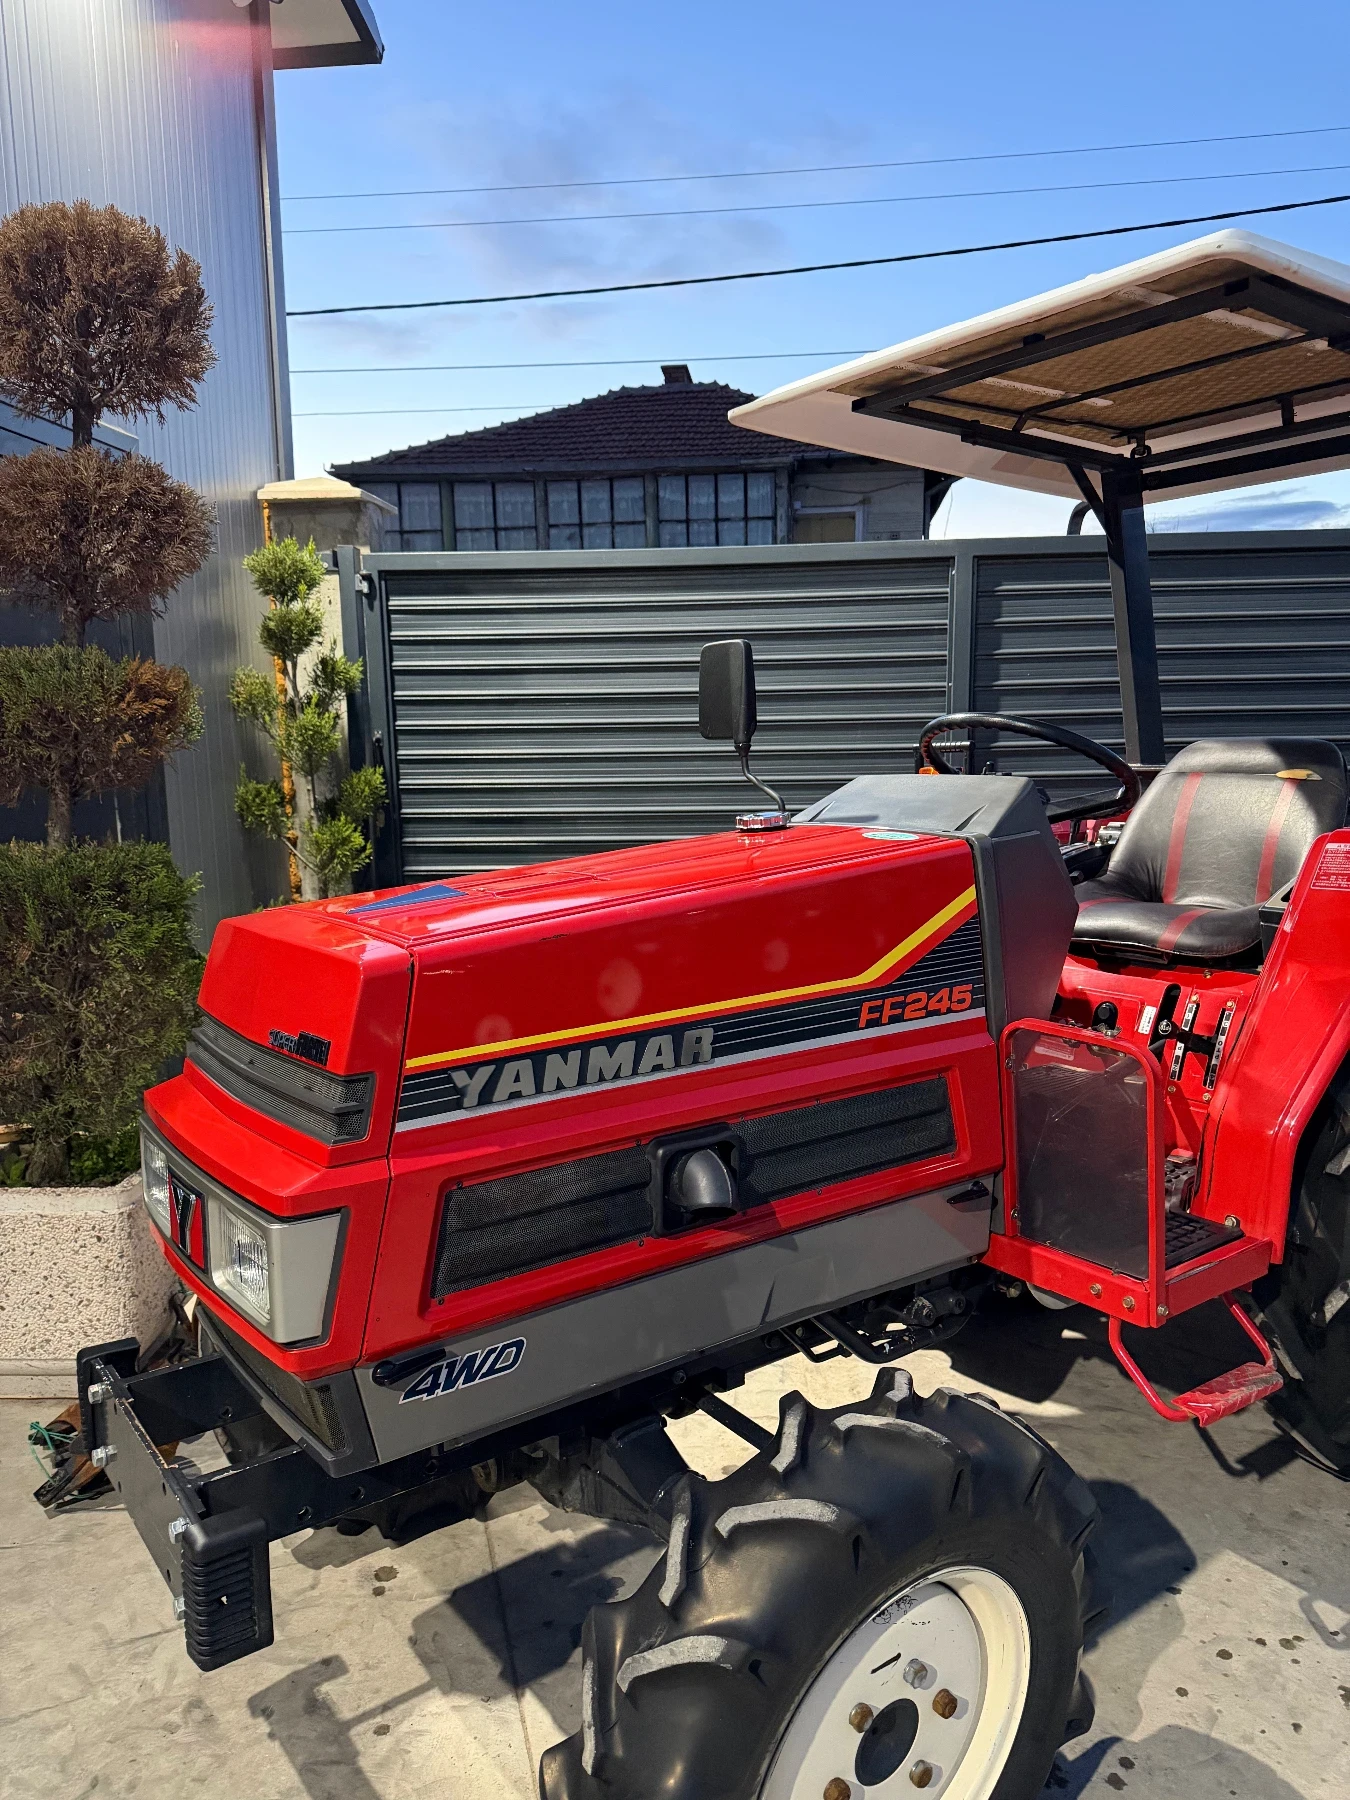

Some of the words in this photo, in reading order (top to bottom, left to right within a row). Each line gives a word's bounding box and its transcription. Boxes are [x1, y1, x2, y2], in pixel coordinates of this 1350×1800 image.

[858, 984, 973, 1028] FF245
[448, 1027, 715, 1108] YANMAR
[399, 1336, 527, 1404] 4WD
